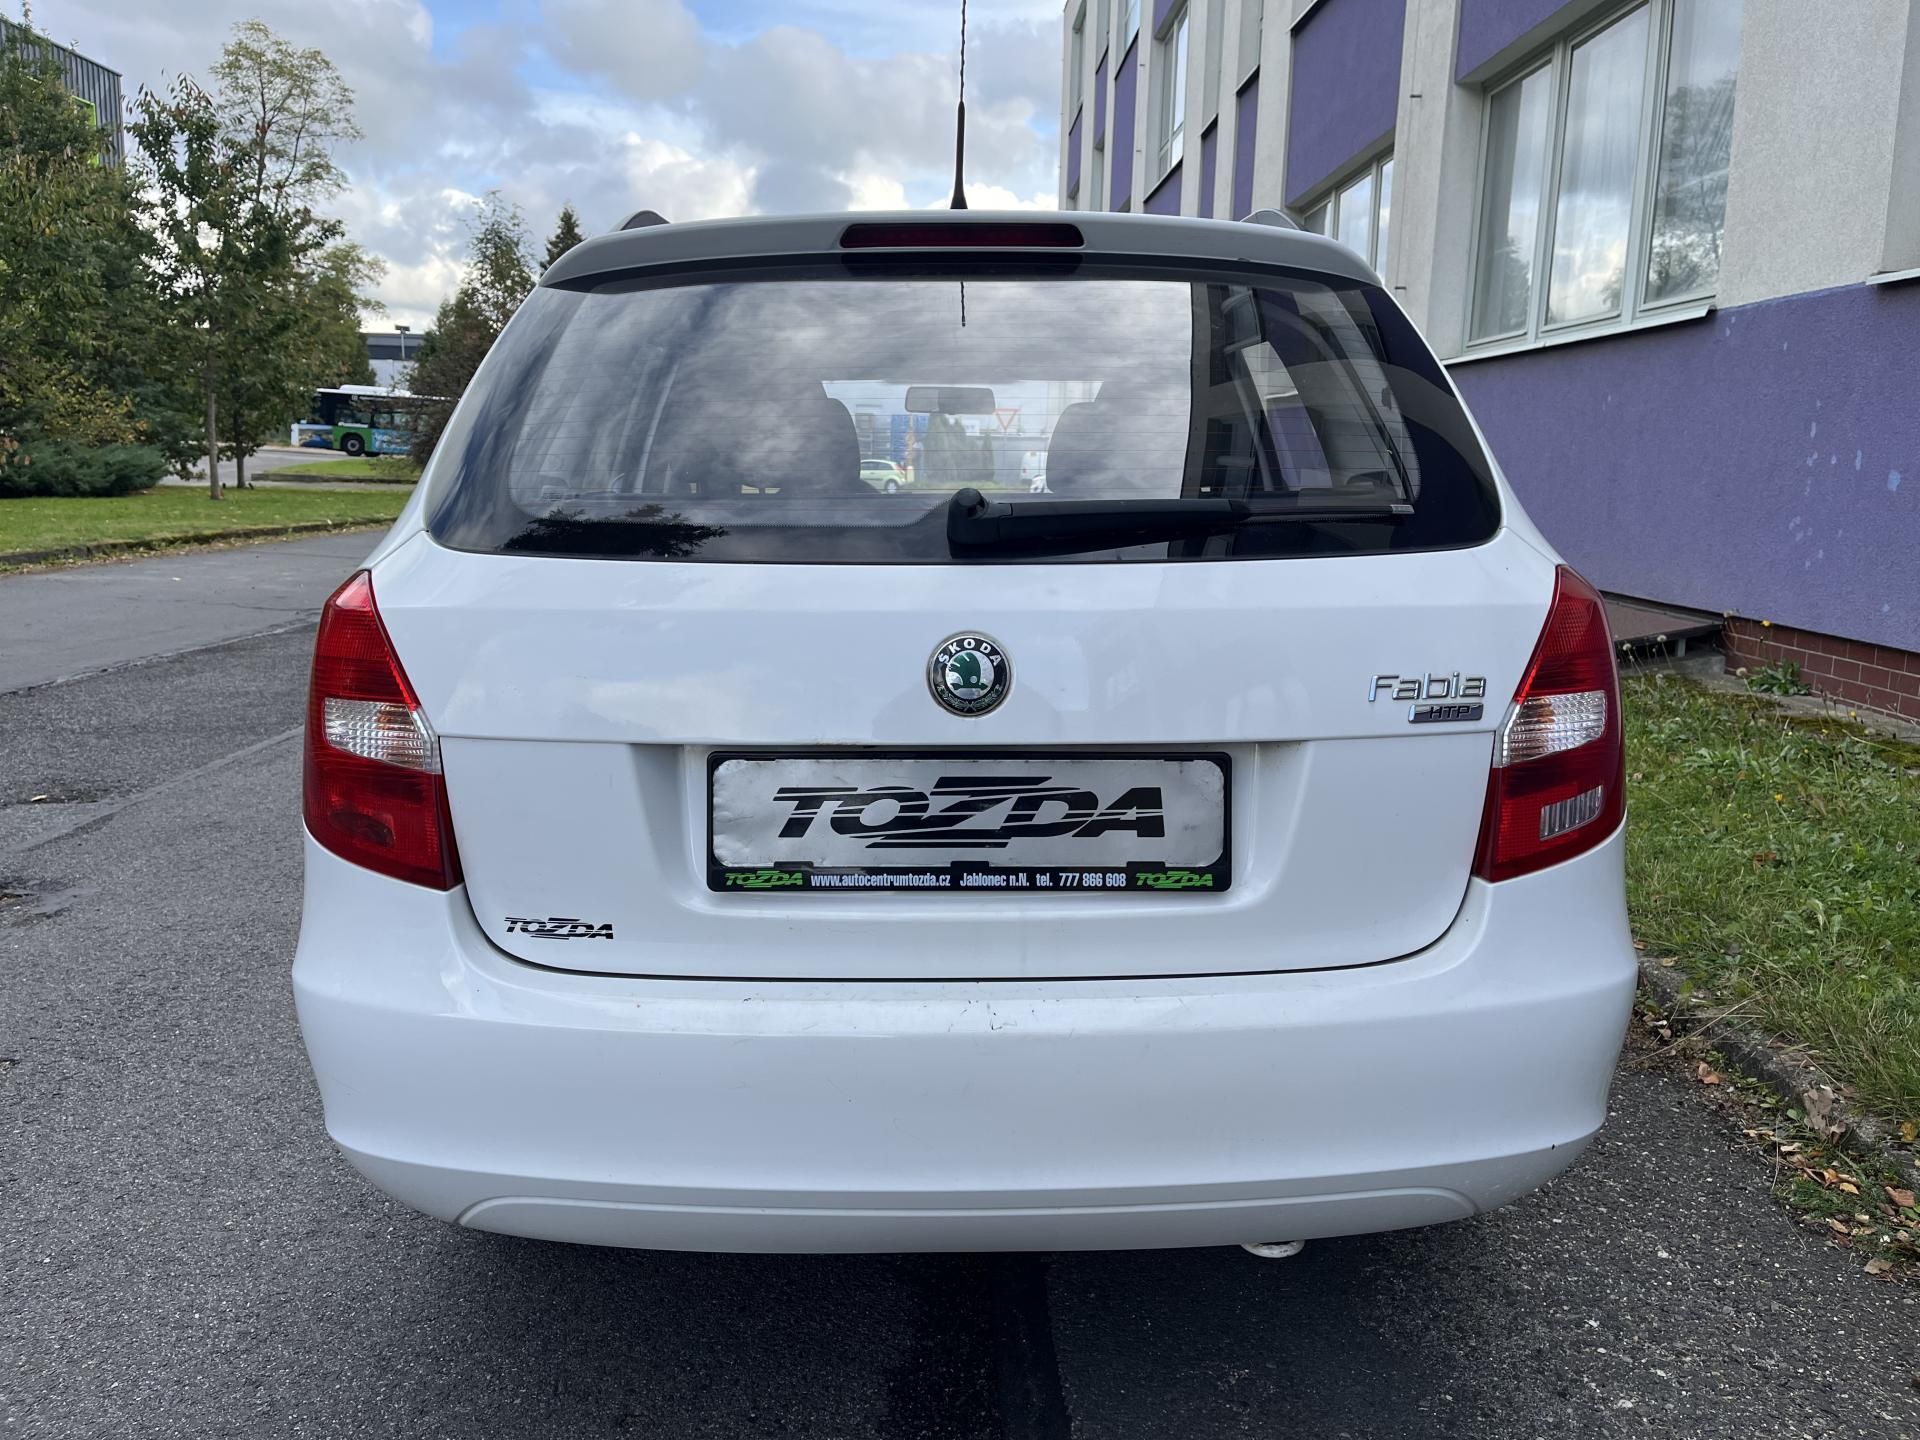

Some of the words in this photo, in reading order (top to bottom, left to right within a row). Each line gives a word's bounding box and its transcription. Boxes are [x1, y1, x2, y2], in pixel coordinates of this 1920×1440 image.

[1368, 671, 1487, 702] Fabia
[1429, 705, 1471, 719] HTP
[772, 776, 1165, 849] TOZDA
[725, 870, 803, 888] TOZDA
[810, 872, 951, 888] www.autocentrumtozda.cz
[959, 872, 1007, 888] Jablonec
[1009, 872, 1030, 887] n.N.
[1036, 872, 1053, 887] tel.
[1059, 872, 1080, 887] 777
[1082, 872, 1103, 887] 866
[1105, 872, 1127, 887] 608
[1136, 870, 1213, 889] TOZDA
[504, 917, 614, 941] TOZDA
